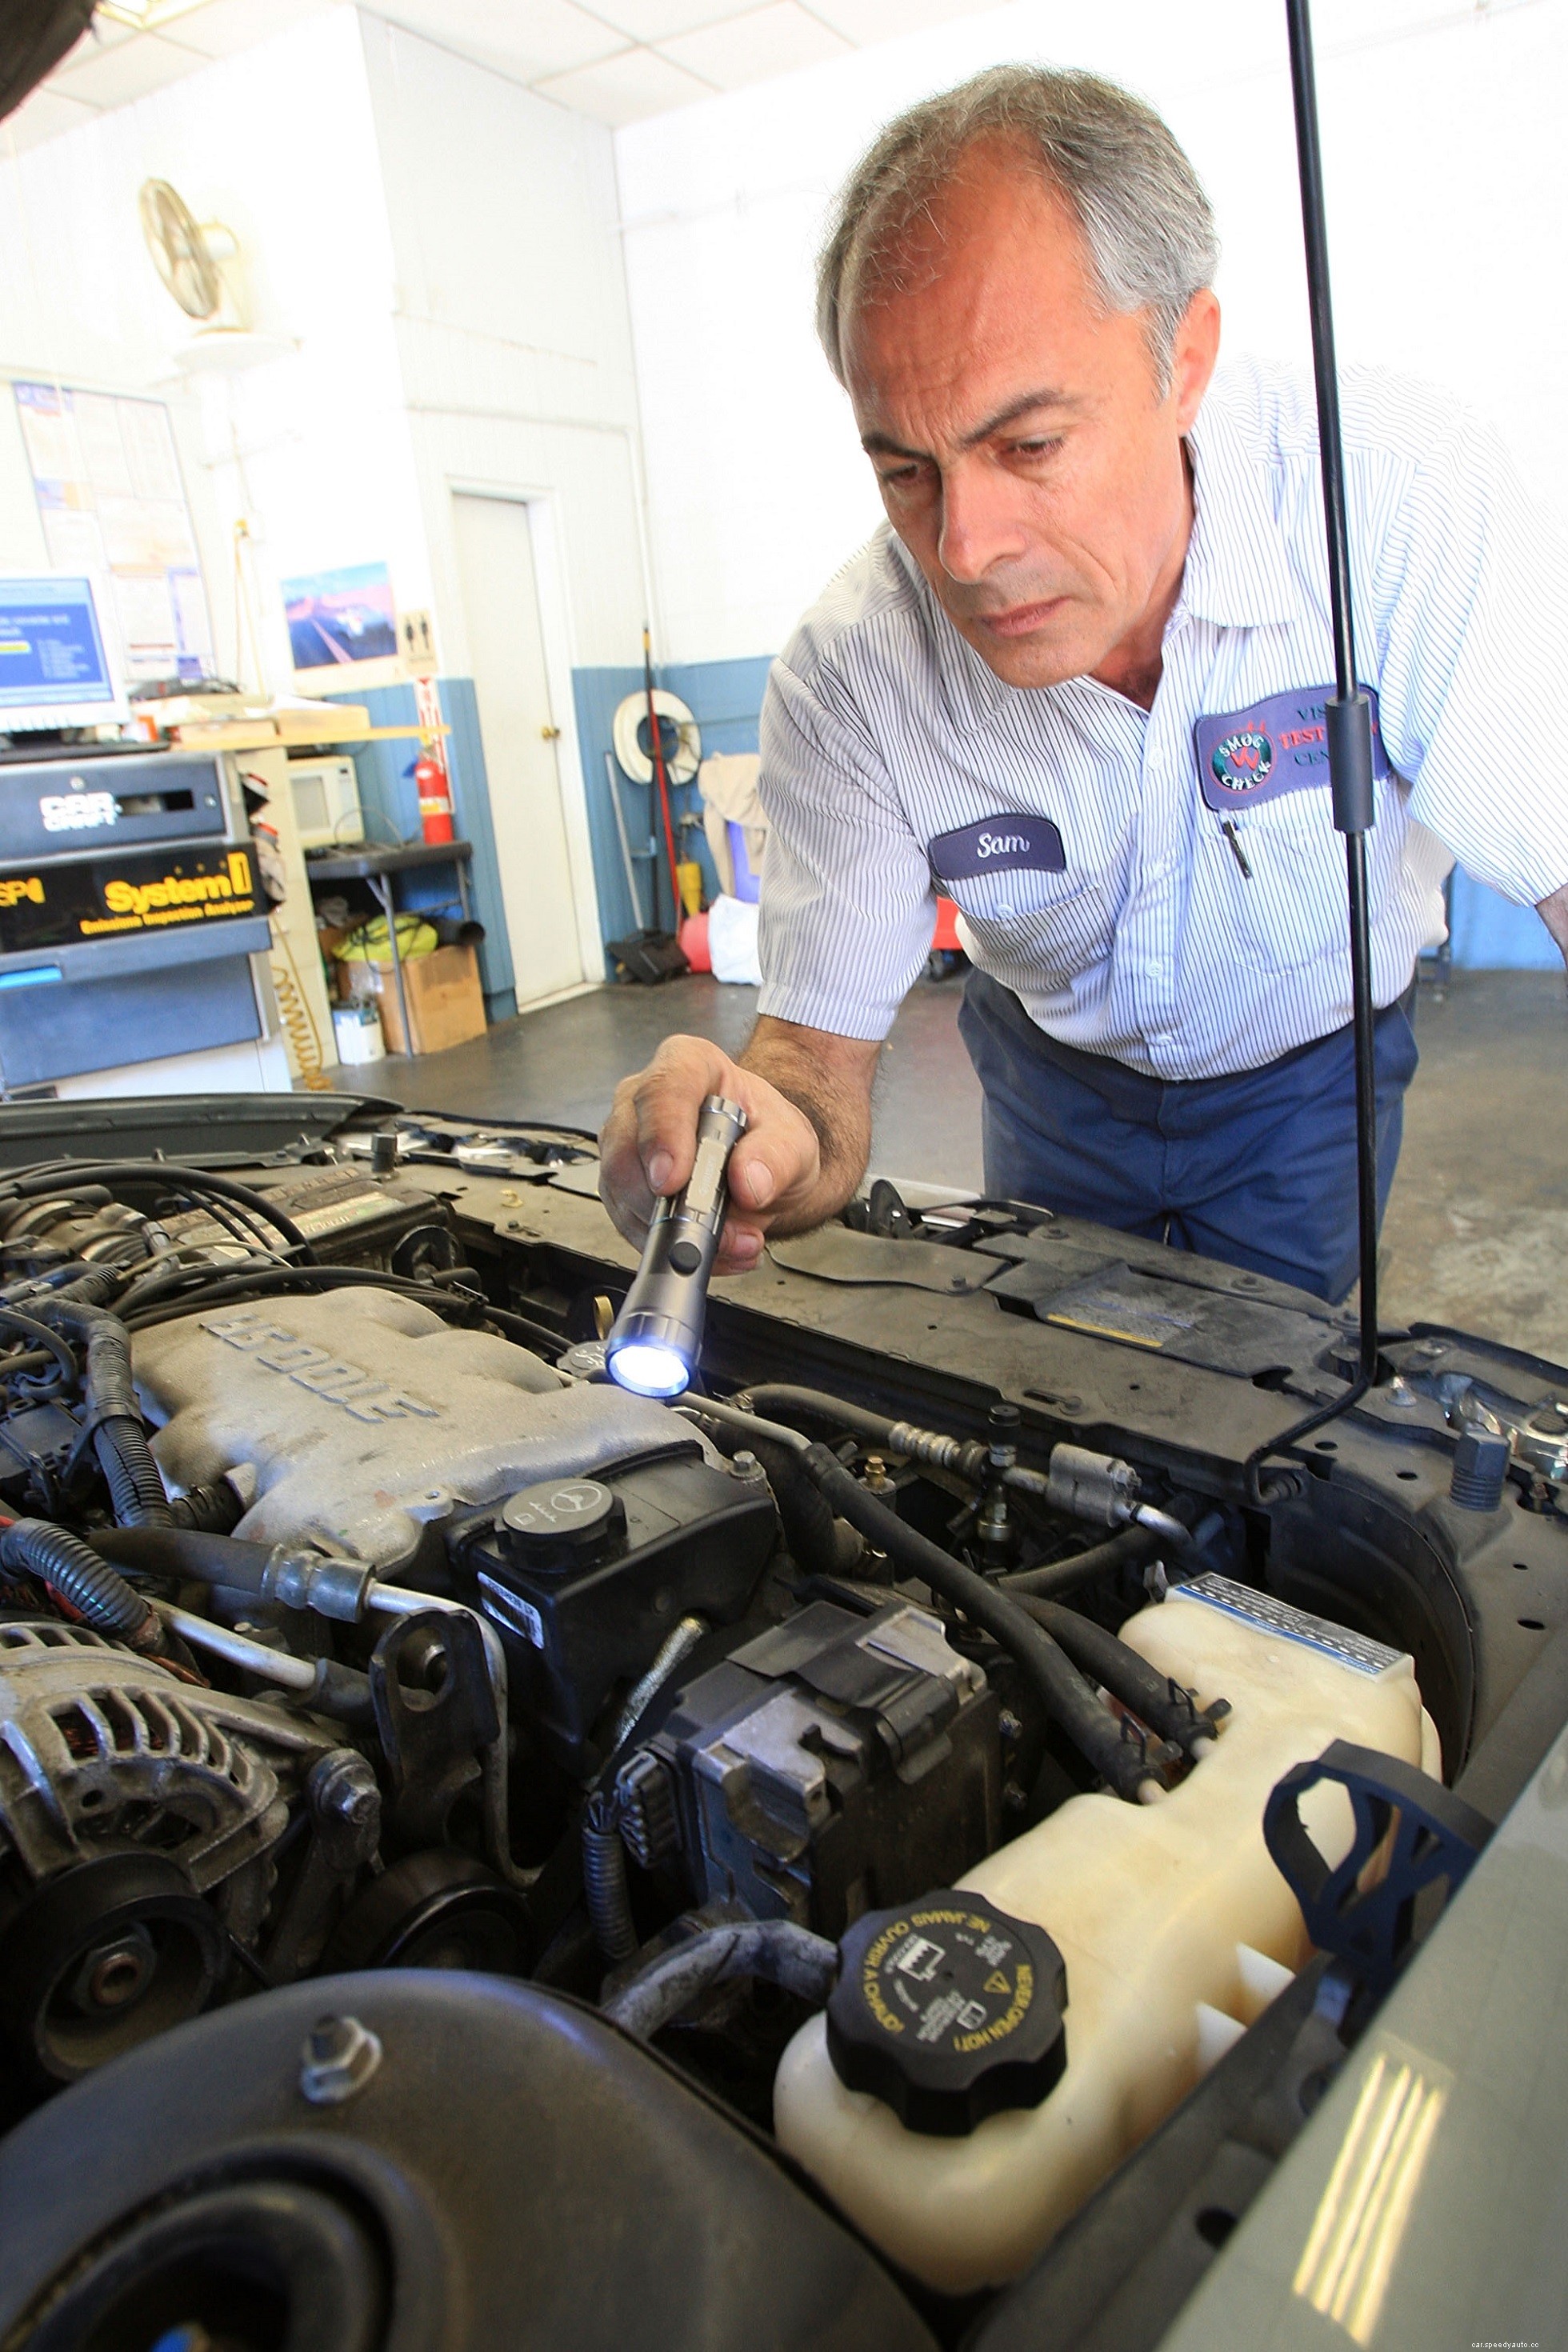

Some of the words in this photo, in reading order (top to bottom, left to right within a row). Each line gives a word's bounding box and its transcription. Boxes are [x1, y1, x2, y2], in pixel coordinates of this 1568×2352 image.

[1218, 732, 1265, 758] SMOG
[1278, 726, 1326, 750] TEST
[1221, 759, 1272, 791] CHECK
[976, 832, 1030, 859] Sam
[104, 874, 234, 915] System
